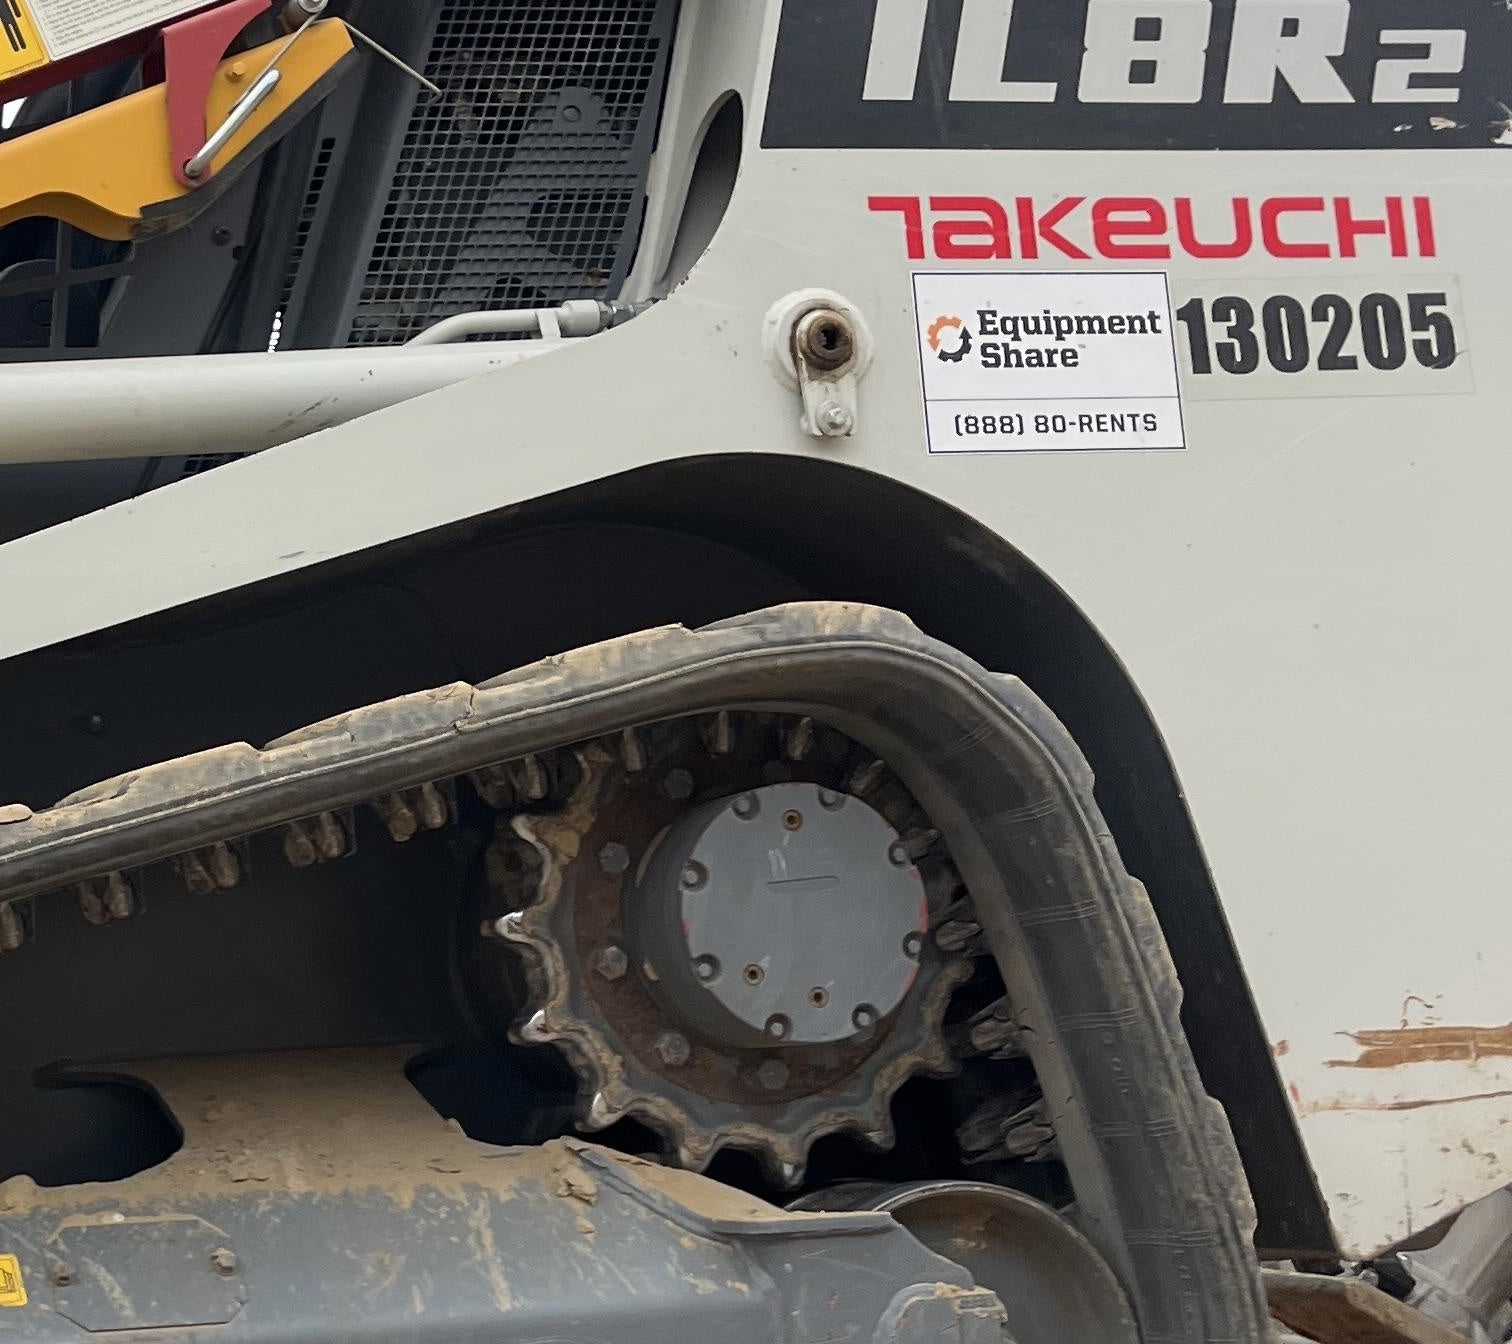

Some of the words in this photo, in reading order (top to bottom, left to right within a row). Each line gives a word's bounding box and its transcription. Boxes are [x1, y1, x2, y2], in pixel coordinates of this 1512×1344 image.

[867, 196, 1437, 260] TAKEUCHI
[976, 309, 1162, 342] Equipment
[1176, 292, 1458, 376] 130205
[980, 342, 1080, 369] Share
[954, 414, 1025, 437] (888)
[1034, 413, 1158, 434] 80-RENTS
